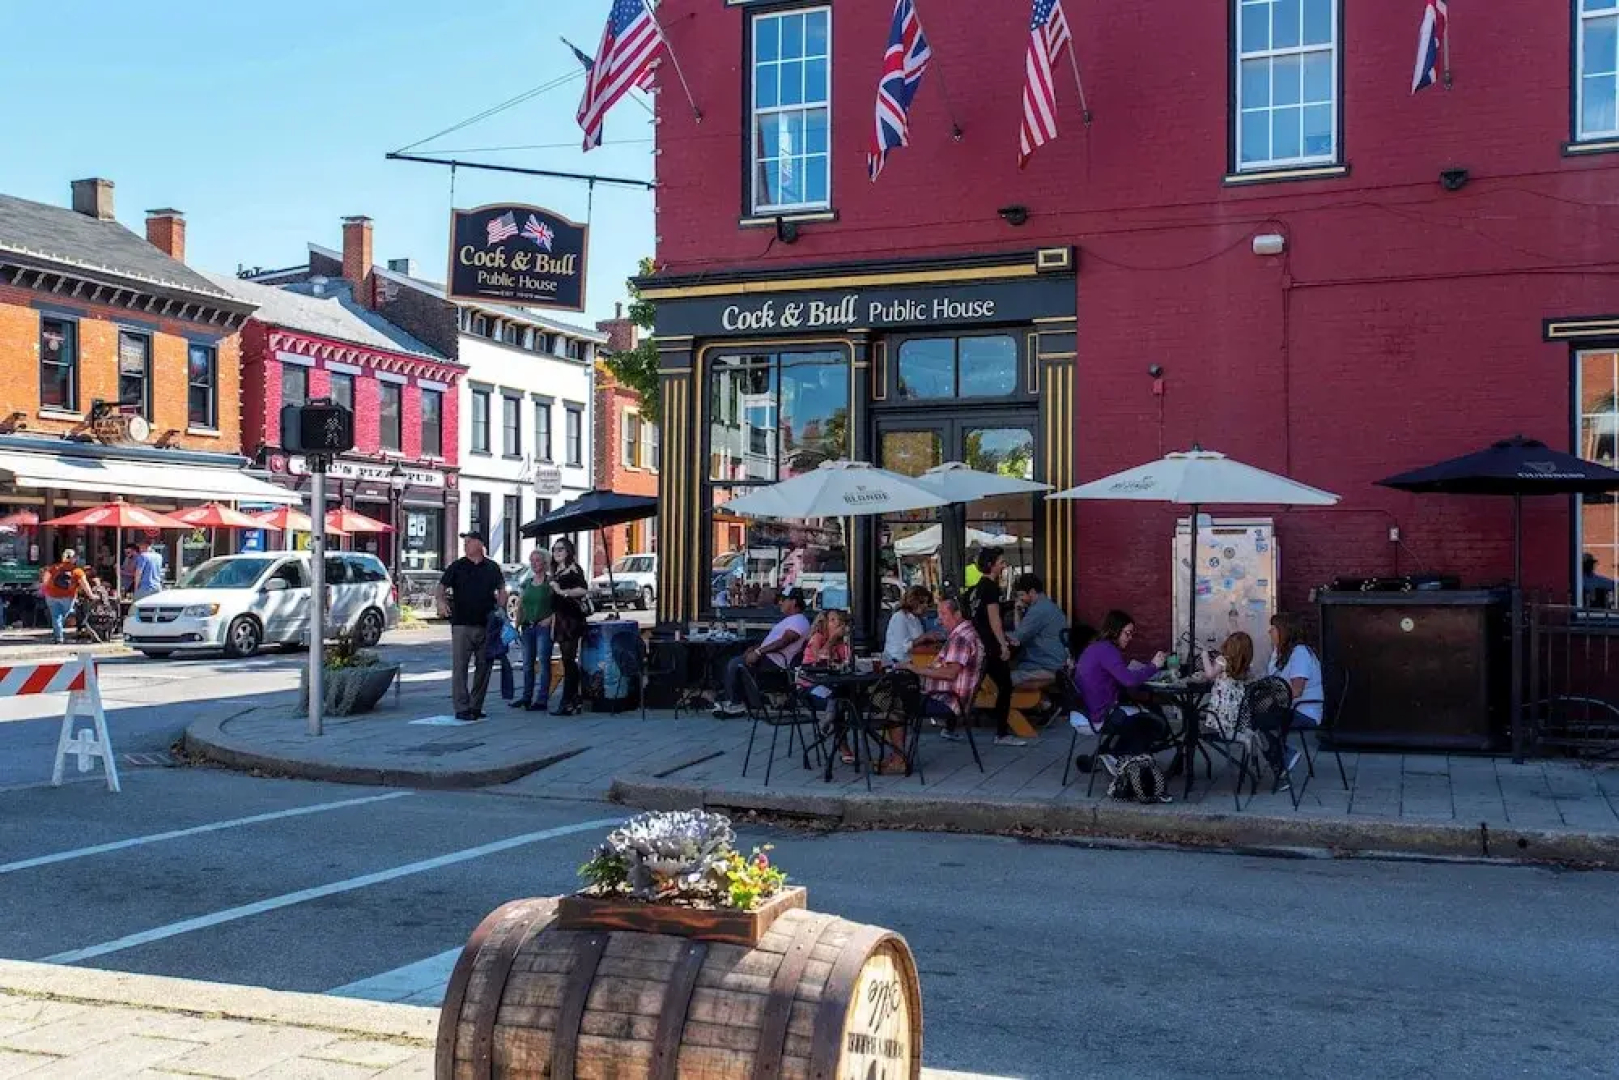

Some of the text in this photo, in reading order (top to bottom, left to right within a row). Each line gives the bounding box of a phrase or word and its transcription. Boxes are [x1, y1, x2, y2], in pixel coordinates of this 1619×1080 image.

[460, 245, 577, 276] Cock & Bull
[477, 271, 558, 291] Public House
[722, 295, 995, 330] Cock & Bull Public House
